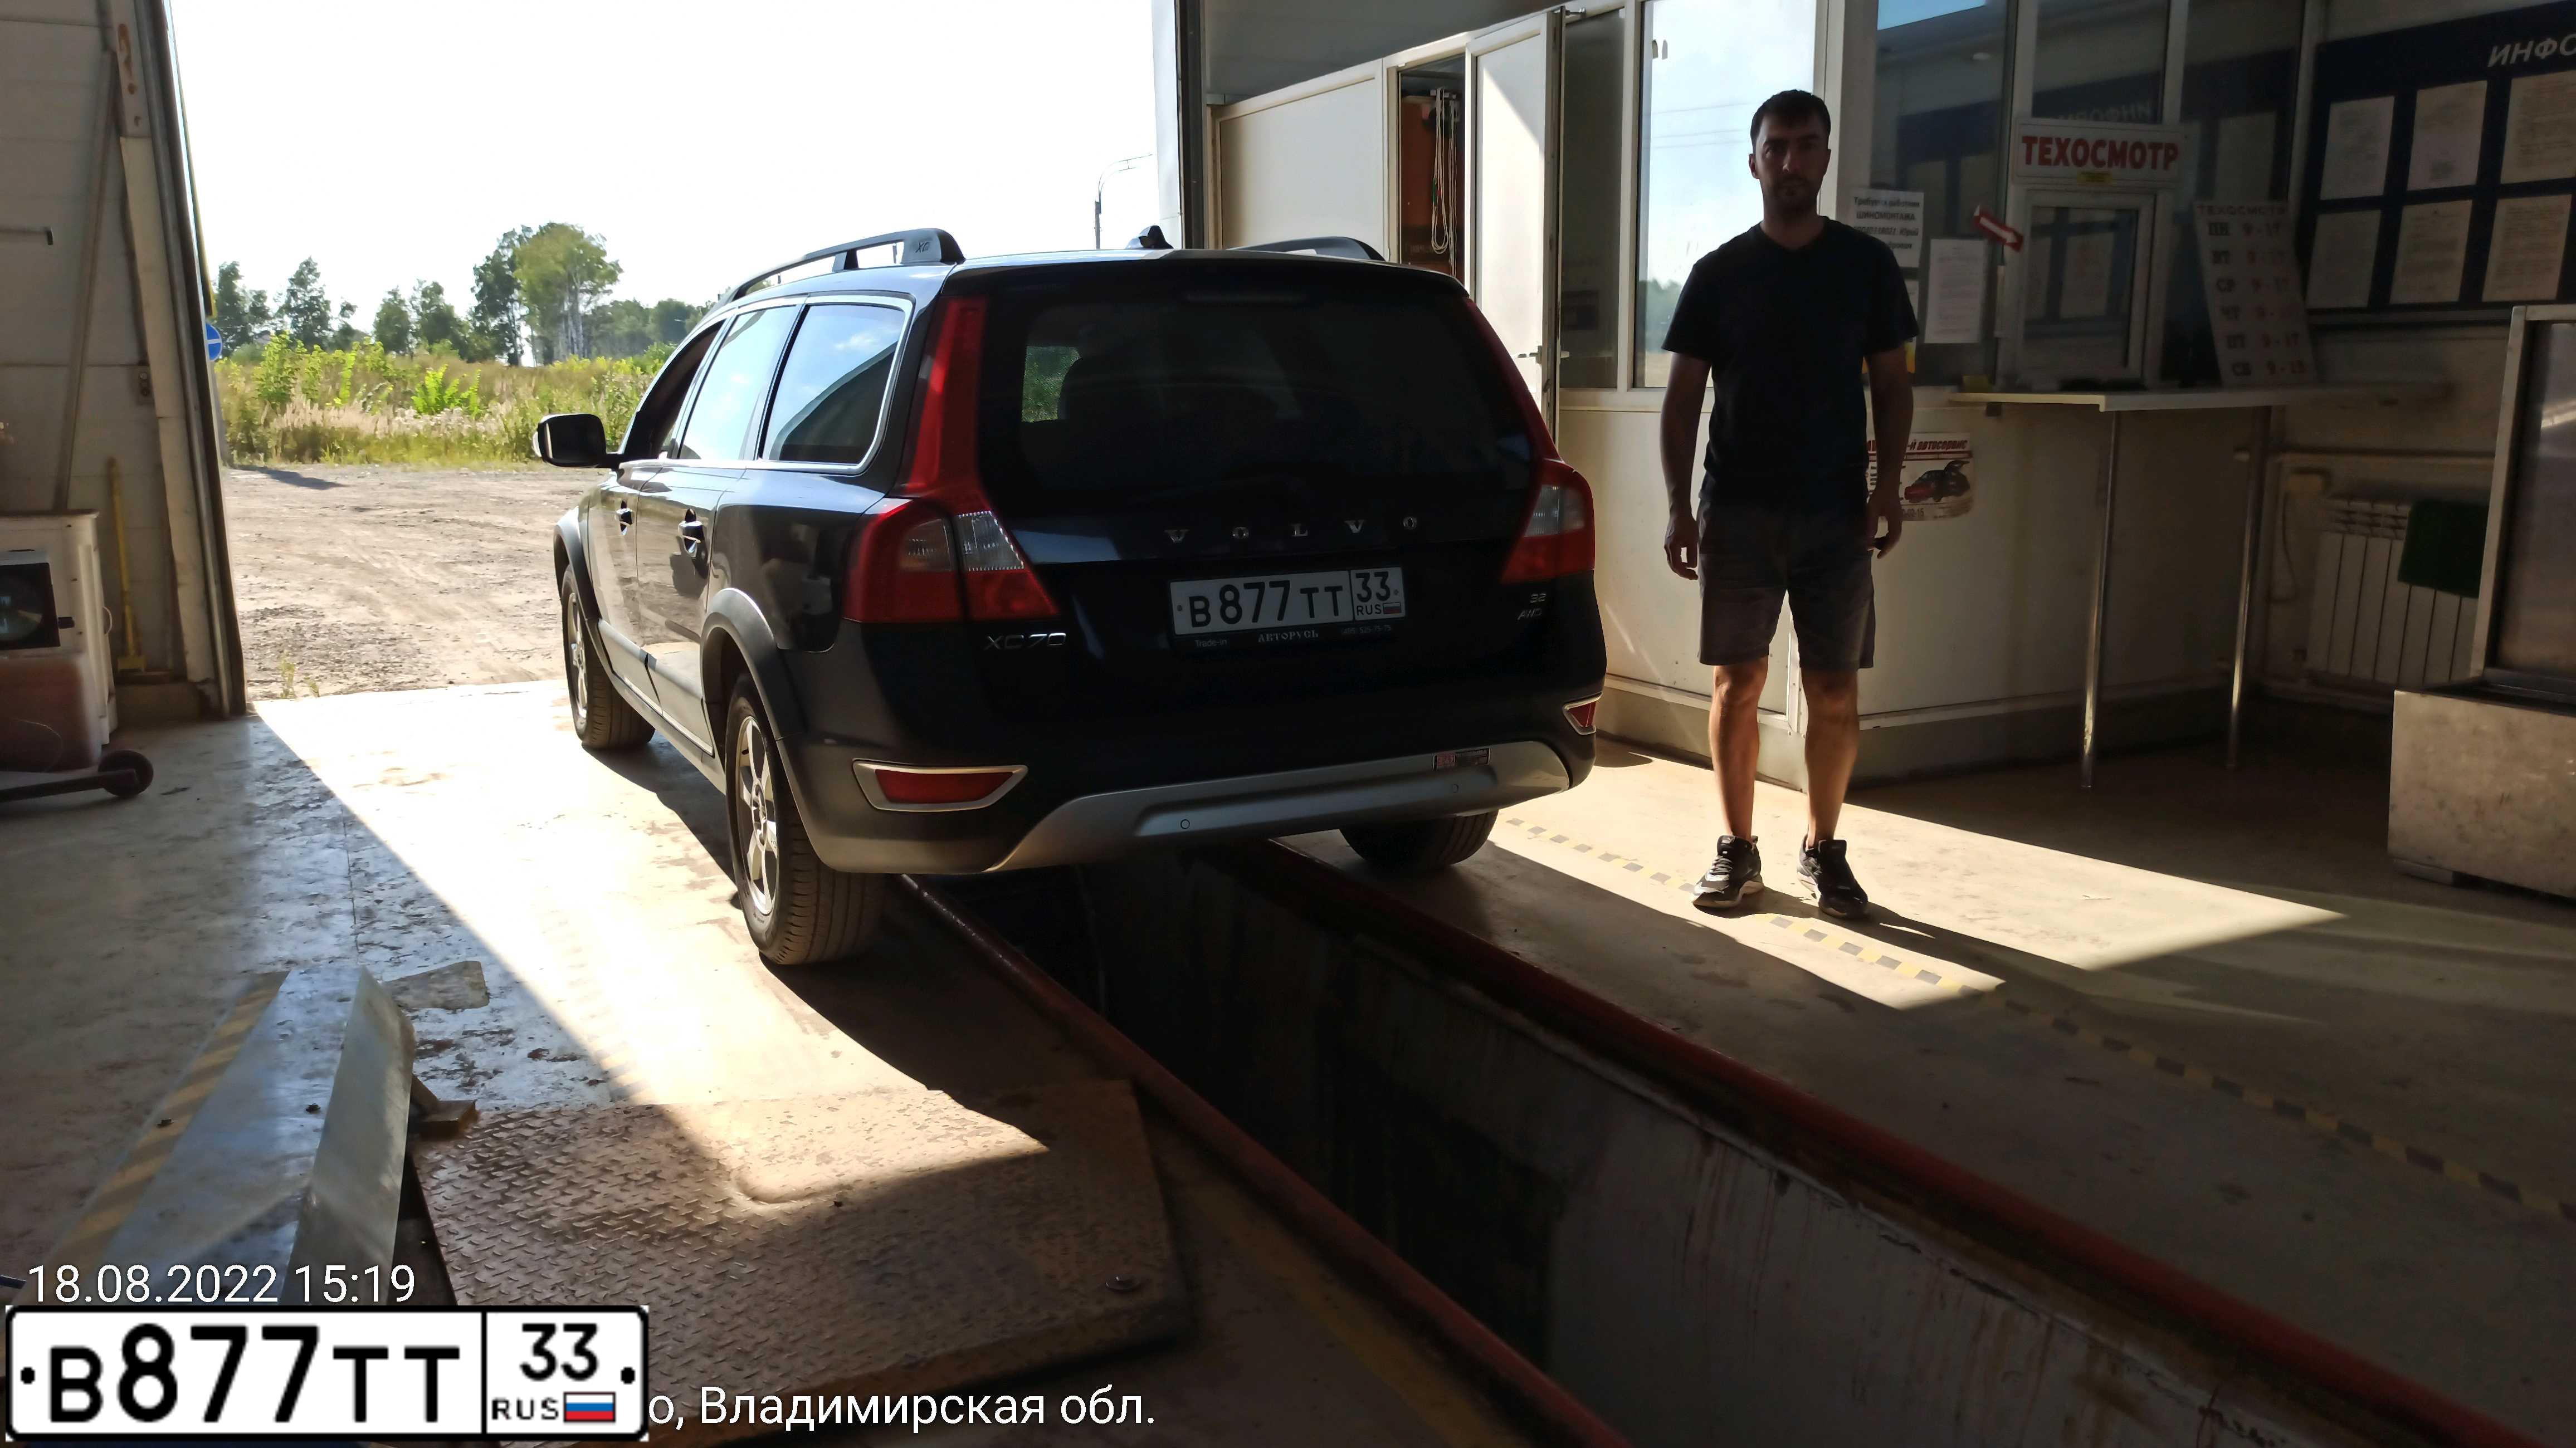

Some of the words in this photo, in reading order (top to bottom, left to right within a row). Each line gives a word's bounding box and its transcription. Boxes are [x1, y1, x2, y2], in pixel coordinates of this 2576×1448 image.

[2022, 136, 2179, 170] ТЕХОСМОТР
[1856, 212, 1915, 221] ШИНОМОНТАЖА
[1164, 516, 1419, 544] VOLVO
[1355, 572, 1391, 603] 33
[1356, 604, 1382, 616] RUS
[983, 633, 1067, 650] XC70
[1194, 639, 1228, 648] Trade-in
[1257, 629, 1320, 643] АВТОРУСЬ
